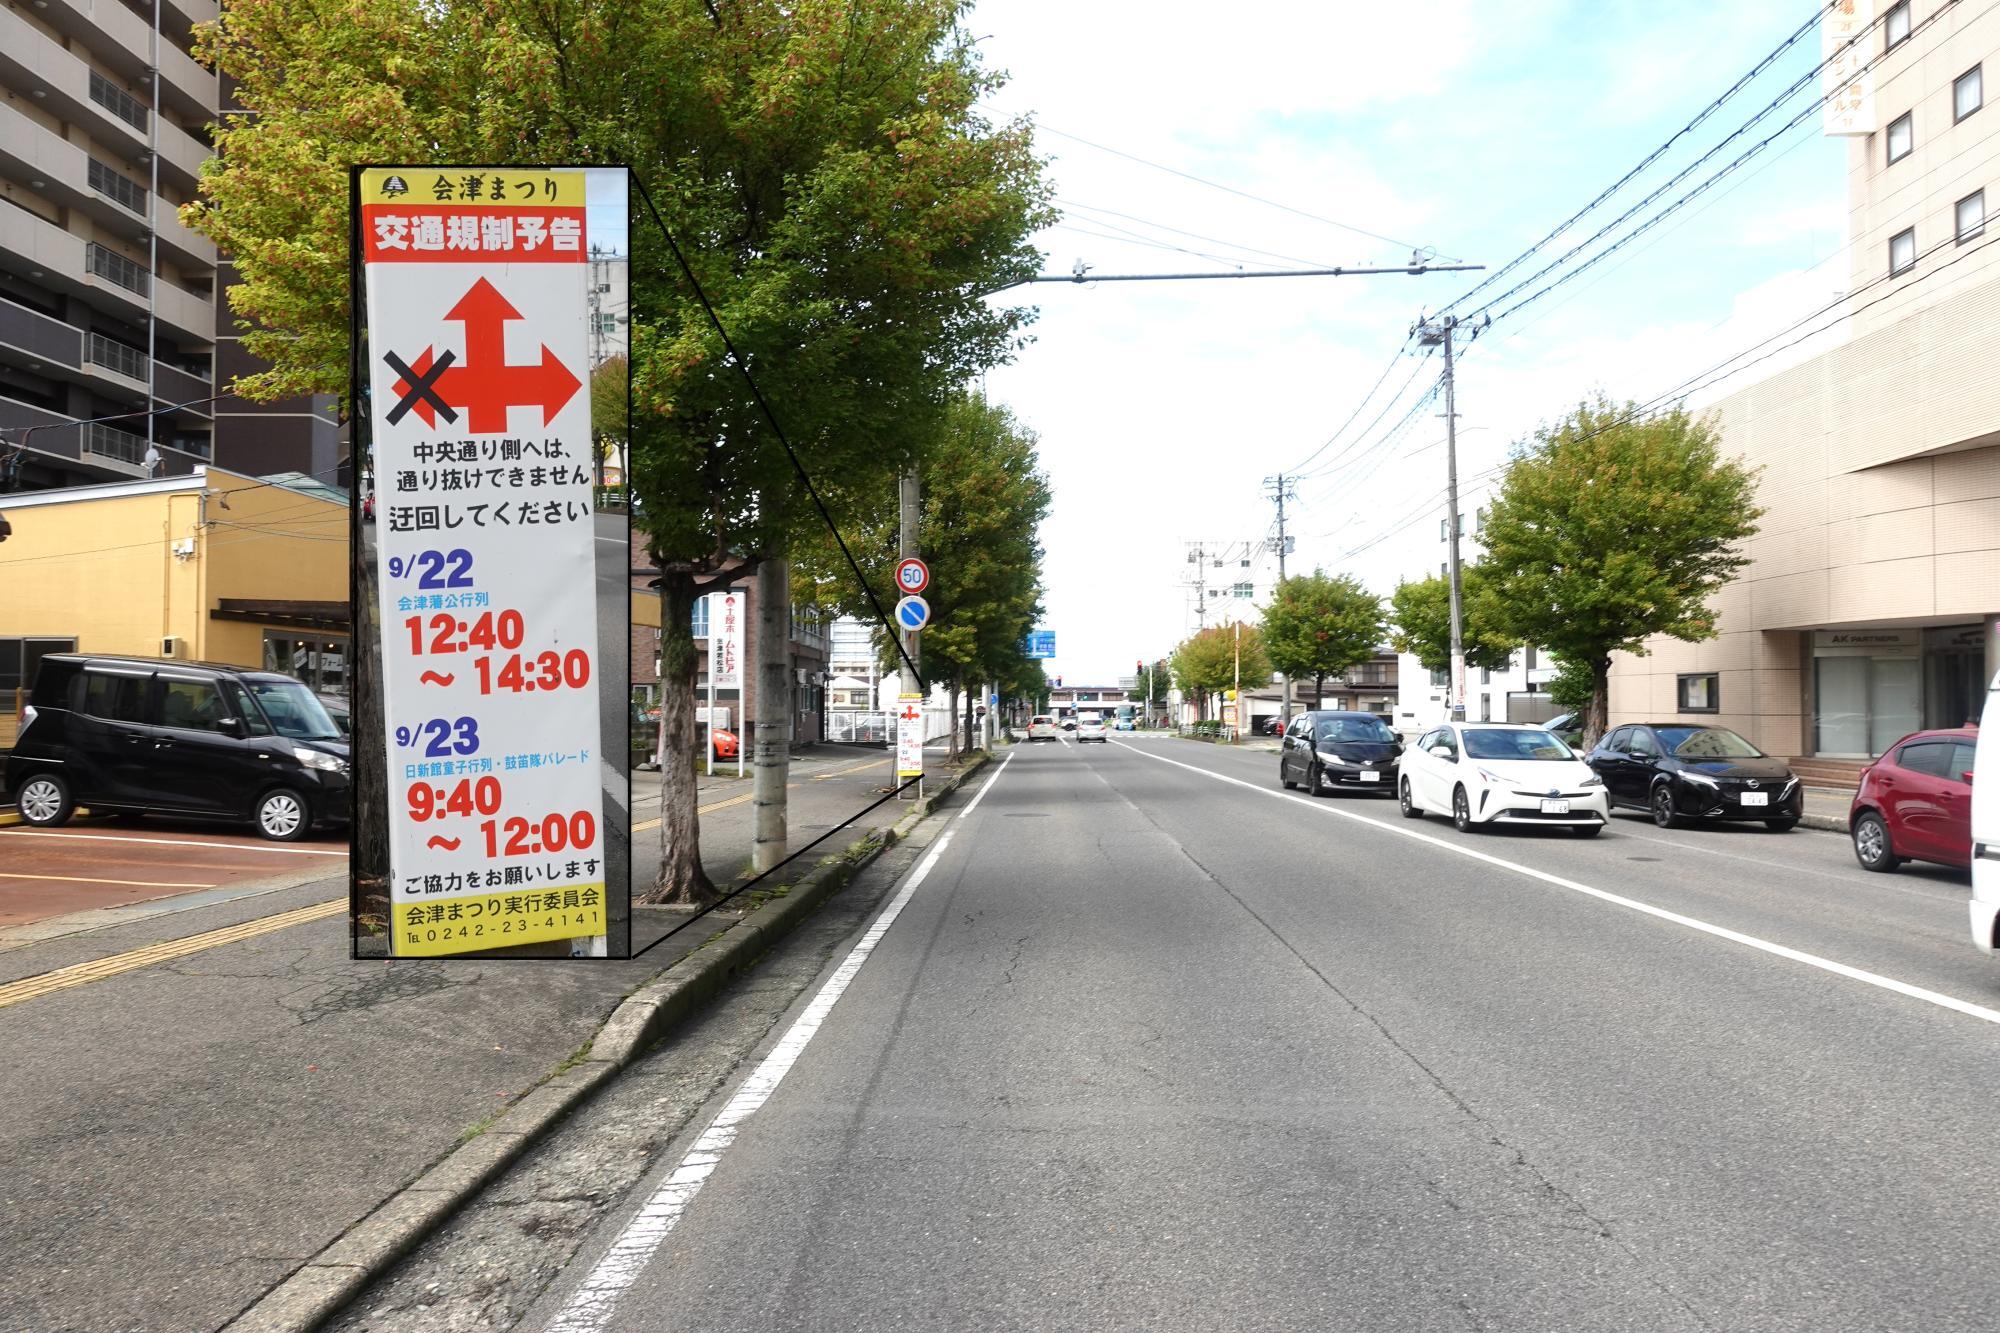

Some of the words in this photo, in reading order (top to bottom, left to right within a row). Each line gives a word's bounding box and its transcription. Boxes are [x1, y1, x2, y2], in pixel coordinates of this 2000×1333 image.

[431, 172, 557, 202] 会津まつり
[374, 214, 582, 251] 交通規制予告
[413, 438, 571, 464] 中央通り側へは、
[396, 464, 590, 492] 通り抜けできません
[389, 500, 589, 532] 迂回してください
[389, 548, 474, 590] 9/22
[903, 568, 922, 584] 50
[397, 591, 490, 612] 会津藩公行列
[405, 609, 525, 656] 12:40
[474, 648, 590, 695] 14:30
[395, 716, 480, 758] 9/23
[407, 775, 502, 823] 9:40
[480, 810, 596, 858] 12:00
[405, 858, 600, 895] ご協力をお願いします
[406, 887, 599, 926] 会津まつり実行委員会
[427, 911, 597, 942] 0242-23-4141
